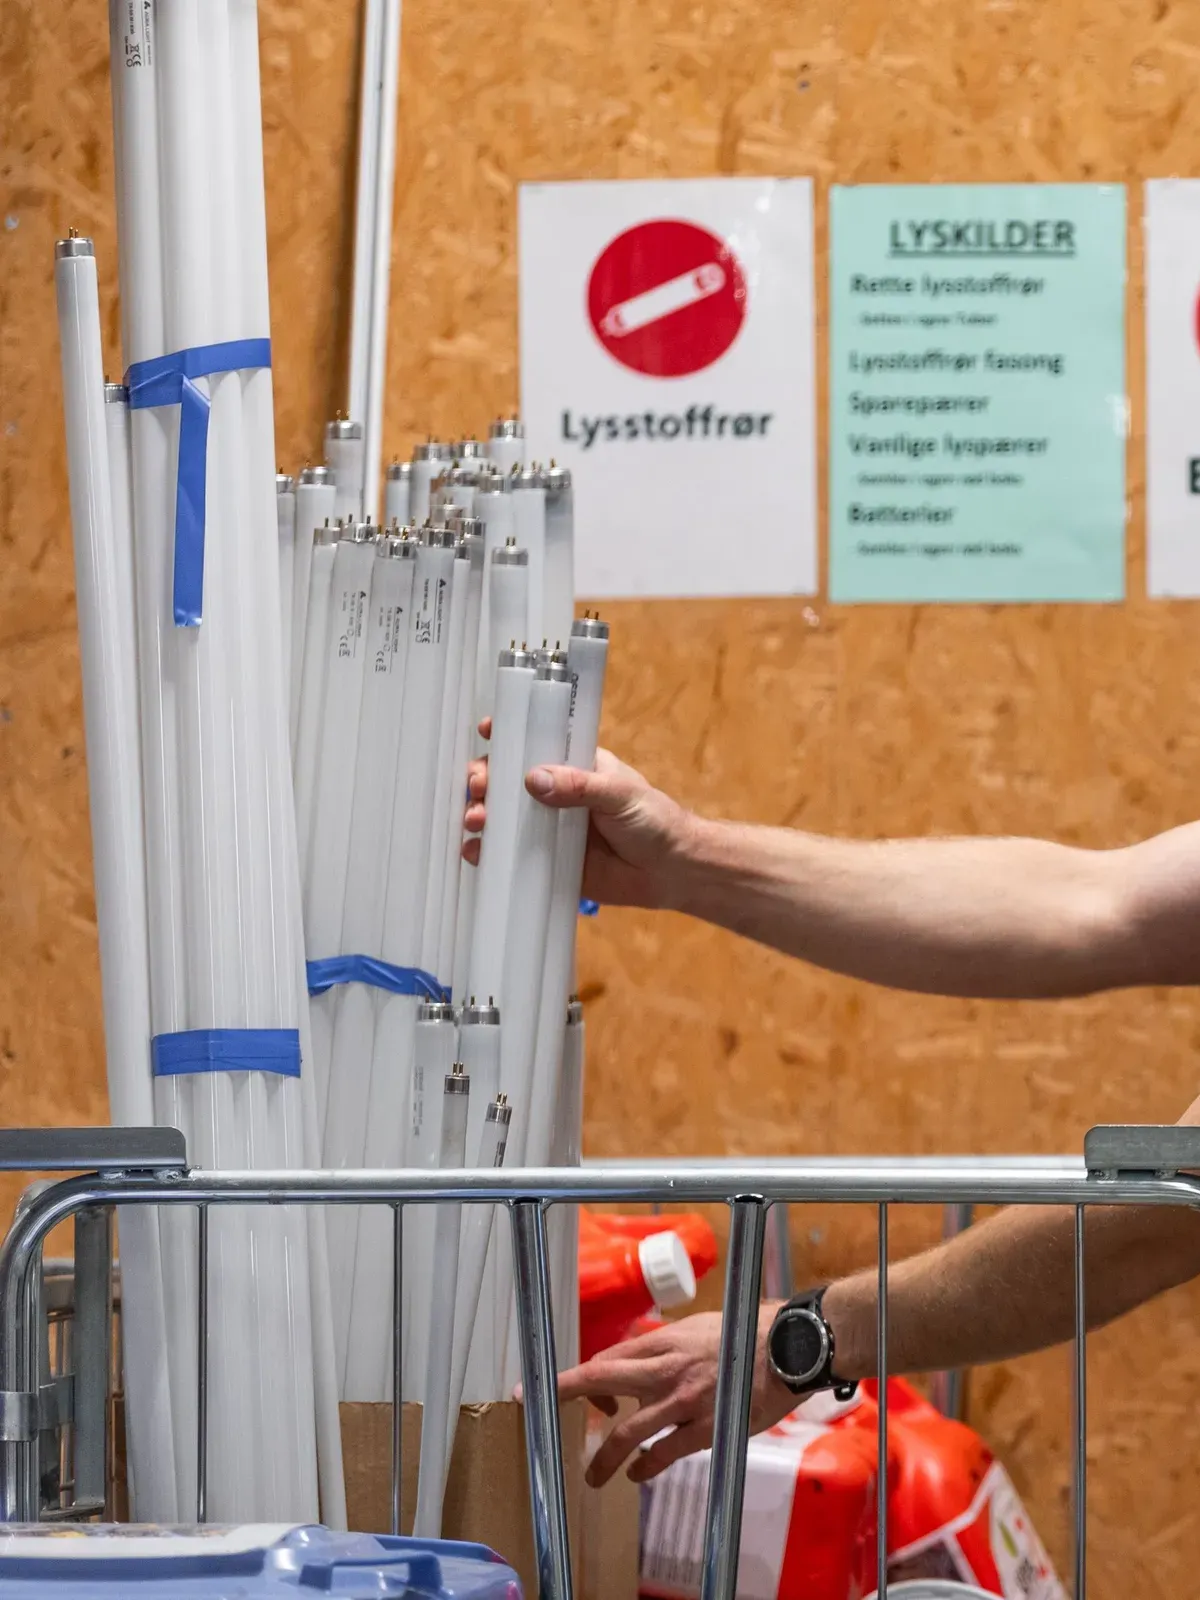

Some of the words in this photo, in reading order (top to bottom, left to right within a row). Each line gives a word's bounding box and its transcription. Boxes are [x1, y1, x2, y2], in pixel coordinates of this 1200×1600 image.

[889, 219, 1076, 250] LYSKILDER
[850, 274, 915, 293] Rette
[561, 403, 773, 451] Lysstoffrør
[848, 434, 938, 458] Vanlige
[848, 504, 954, 525] Batterier
